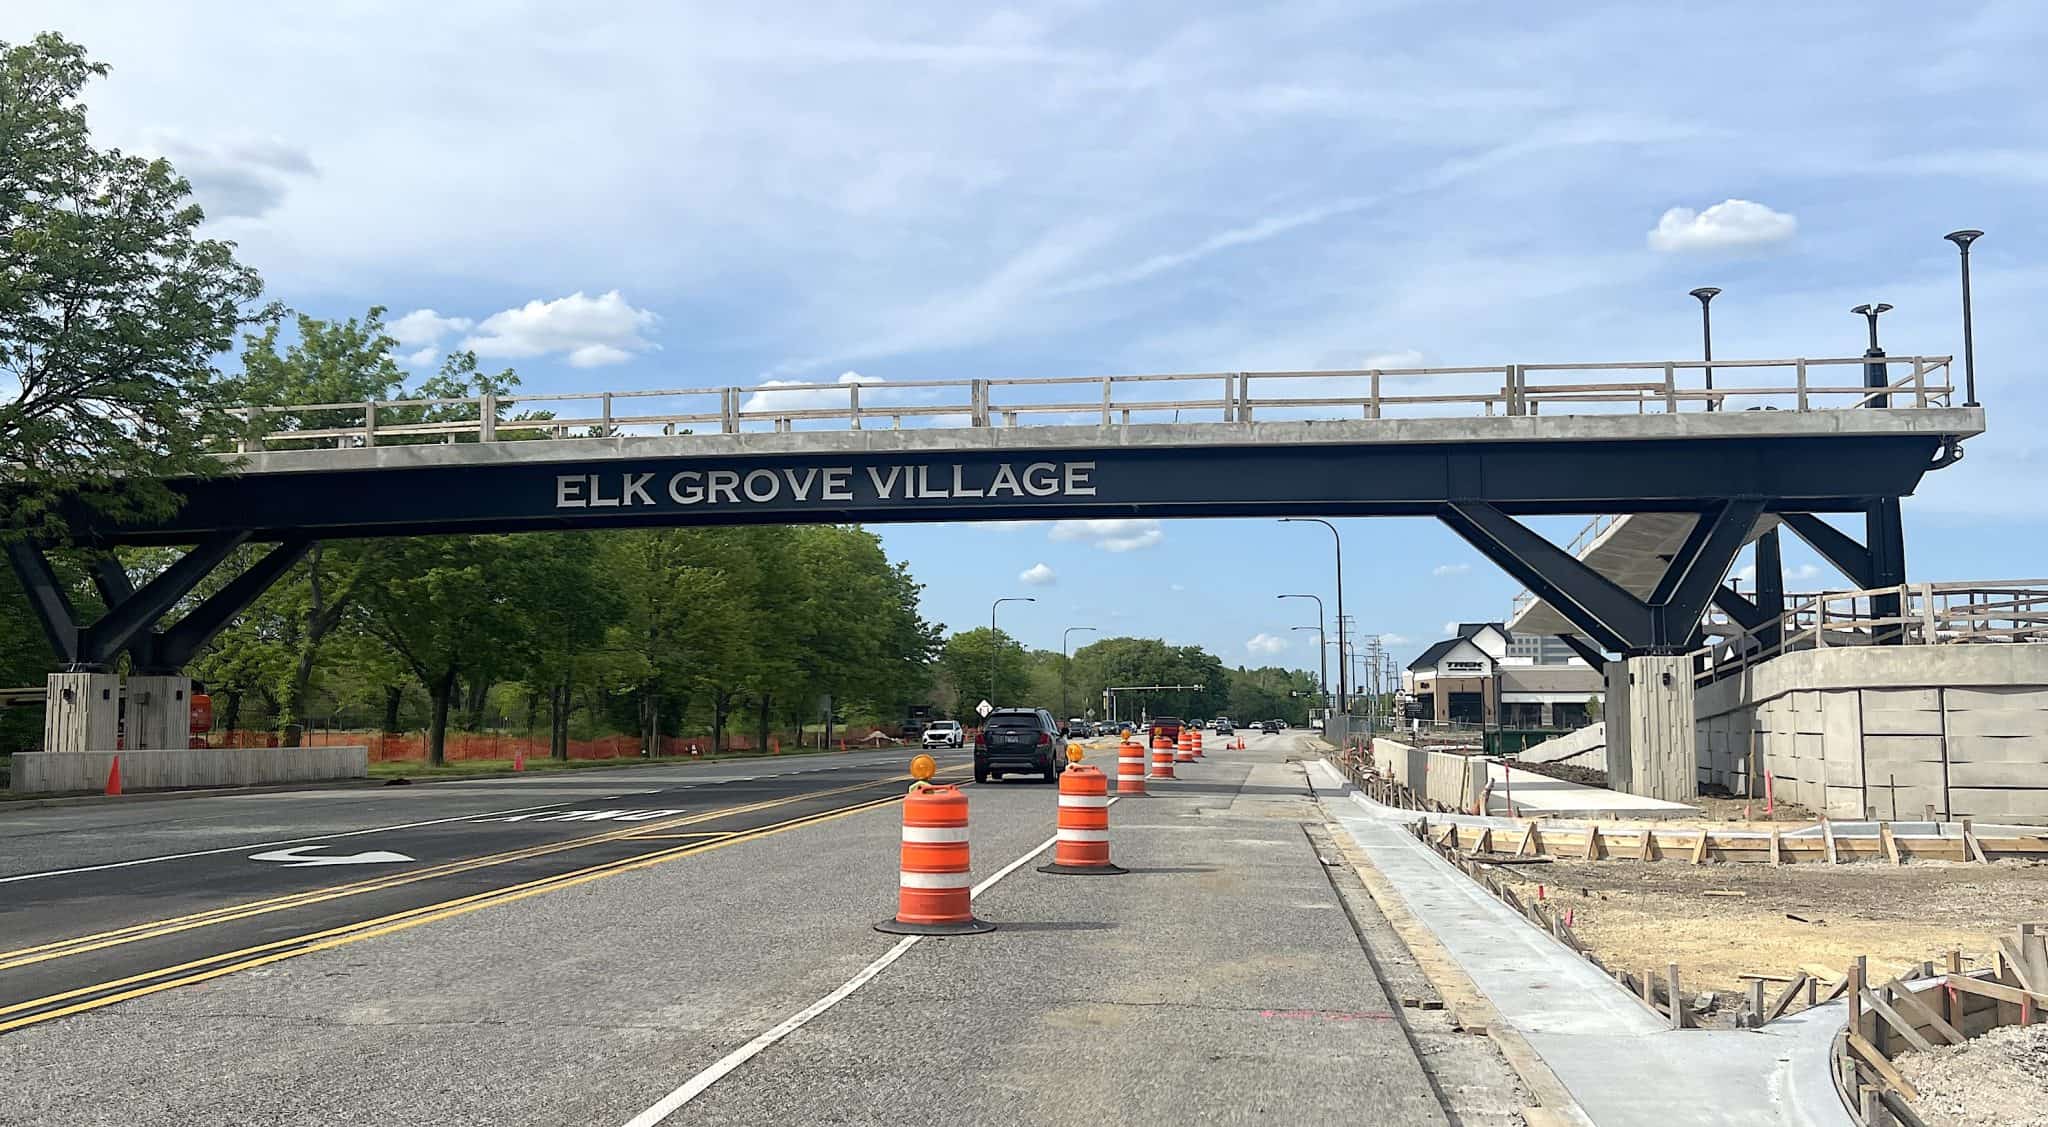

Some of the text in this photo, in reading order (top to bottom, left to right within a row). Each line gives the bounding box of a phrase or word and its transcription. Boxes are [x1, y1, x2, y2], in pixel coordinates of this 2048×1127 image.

[556, 461, 1097, 508] ELK GROVE VILLAGE
